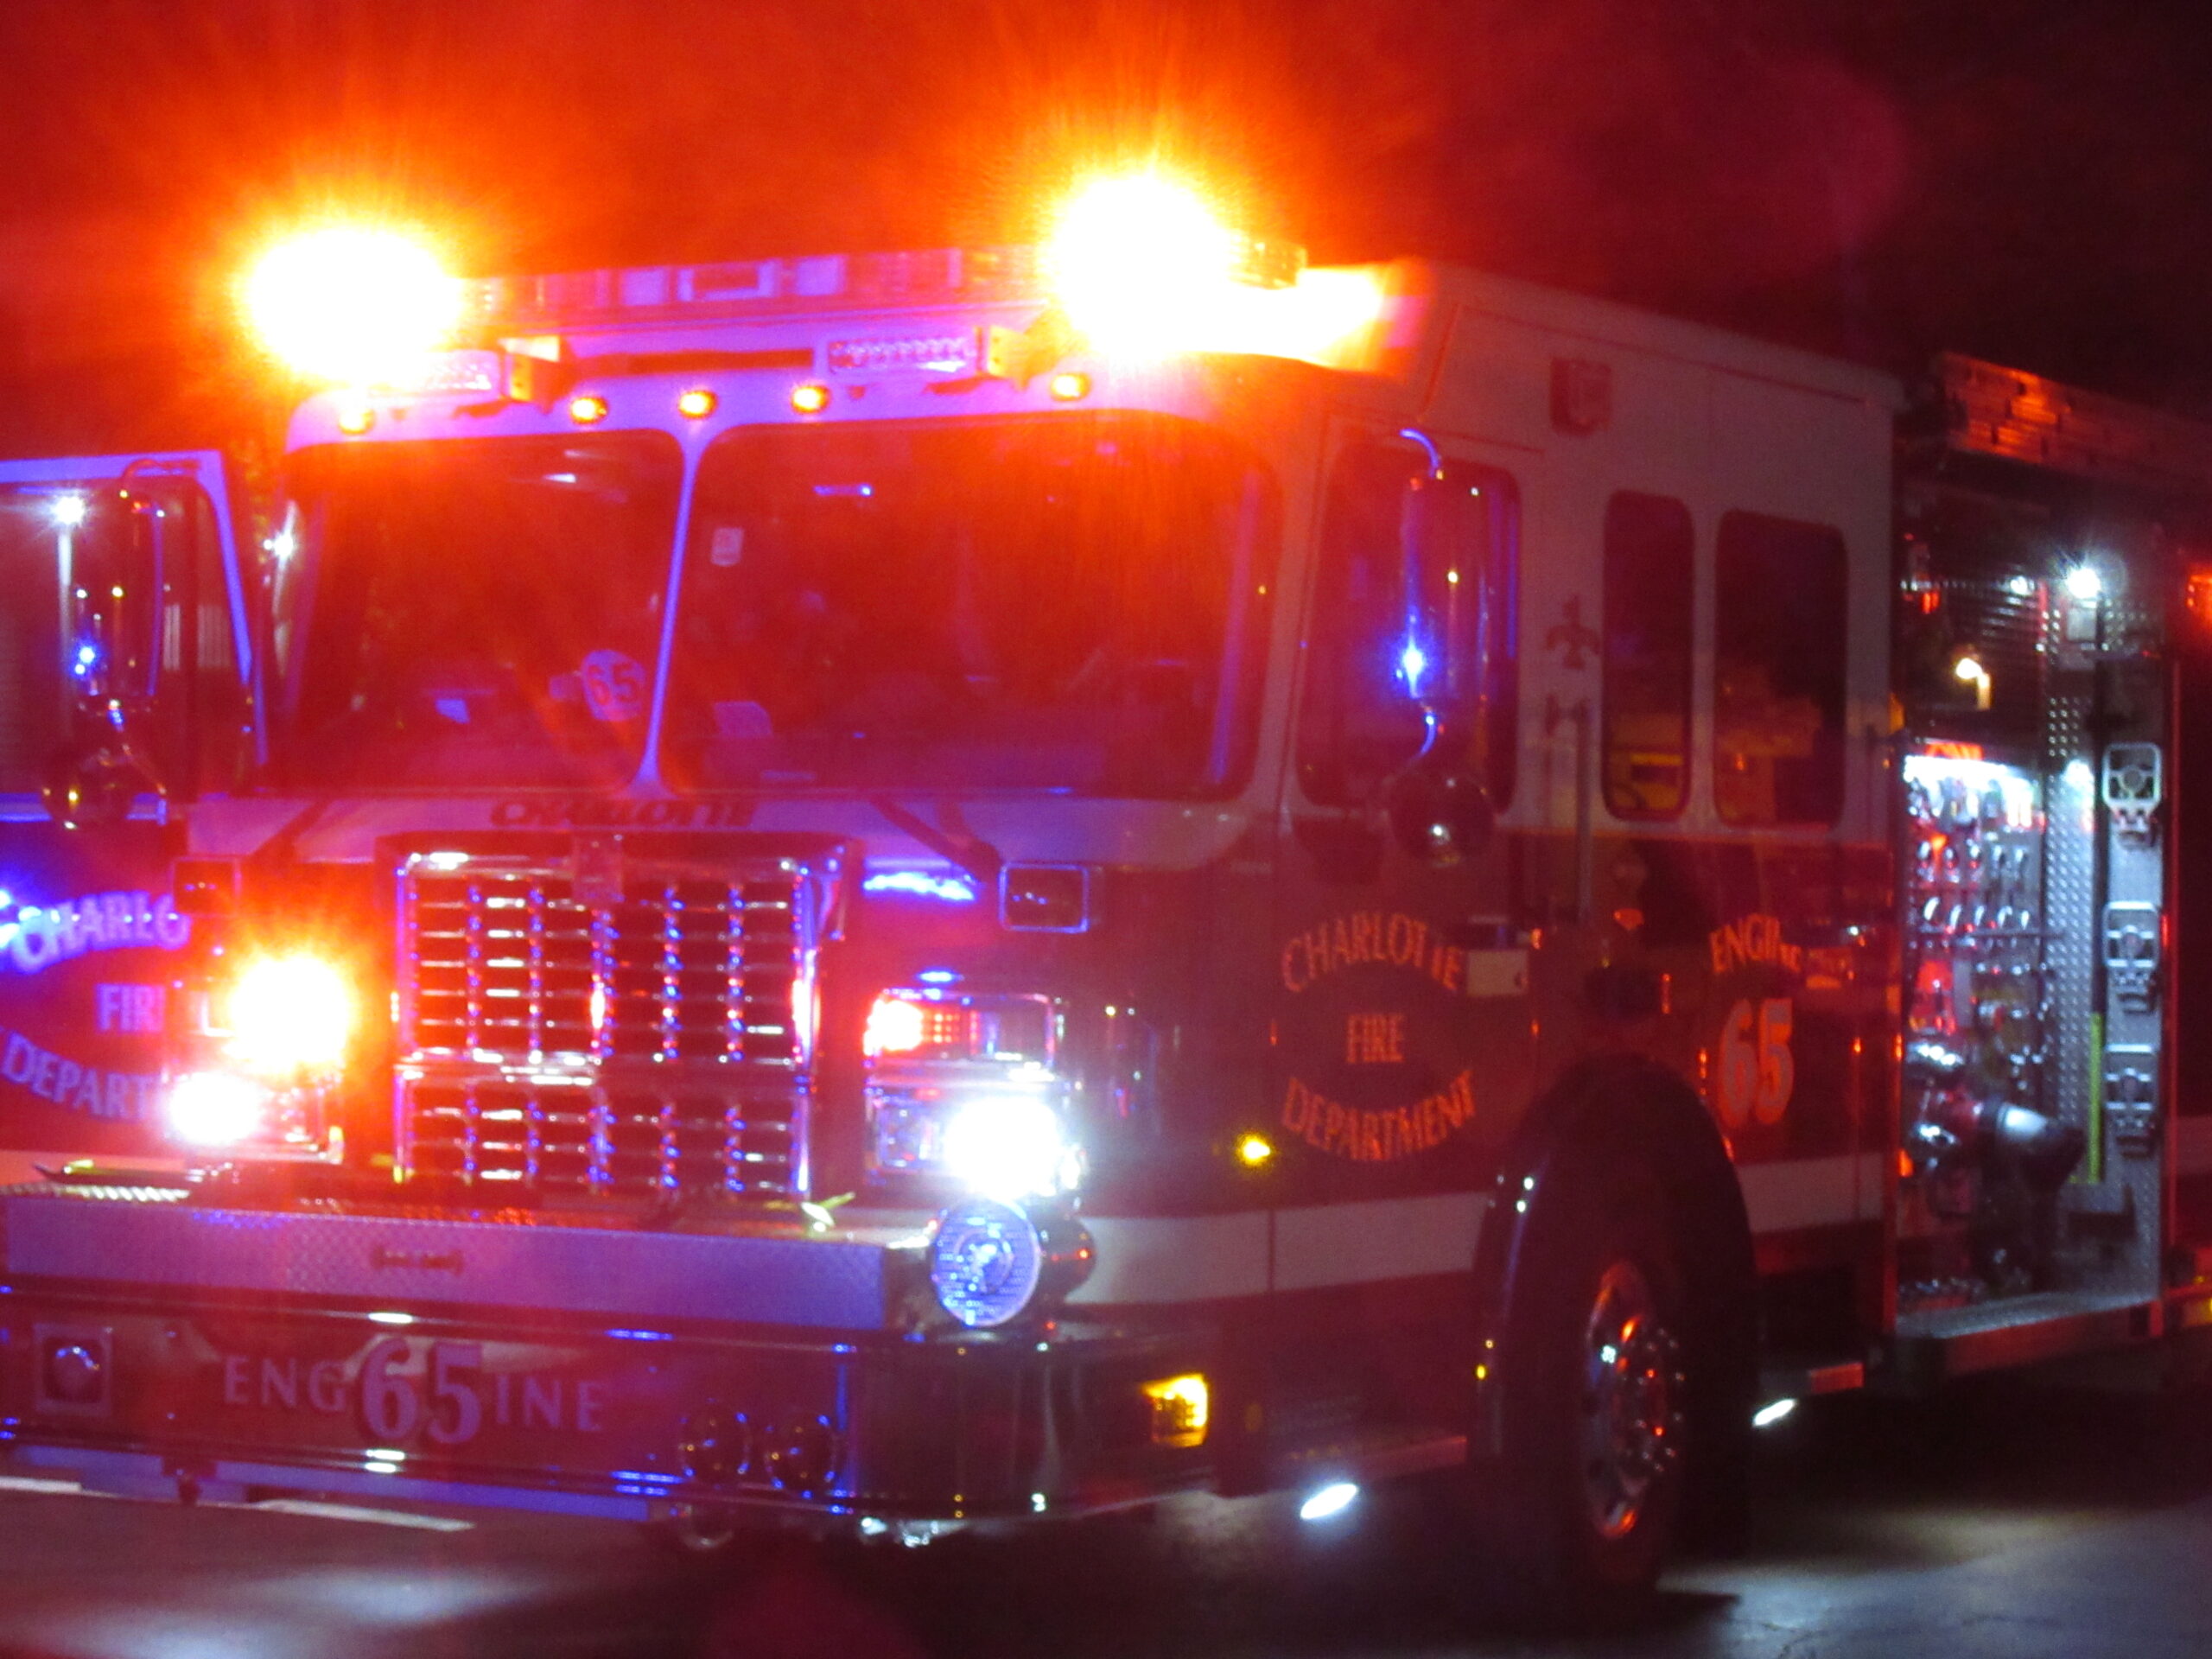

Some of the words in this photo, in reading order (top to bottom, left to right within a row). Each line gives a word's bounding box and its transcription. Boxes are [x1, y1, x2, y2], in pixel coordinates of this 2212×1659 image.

[586, 661, 640, 708] 65
[1346, 1014, 1405, 1063] FIRE
[1718, 998, 1794, 1125] 65
[1284, 1070, 1474, 1160] DEPARTMENT
[223, 1357, 347, 1412] ENG
[361, 1336, 482, 1444] 65
[494, 1374, 605, 1433] INE
